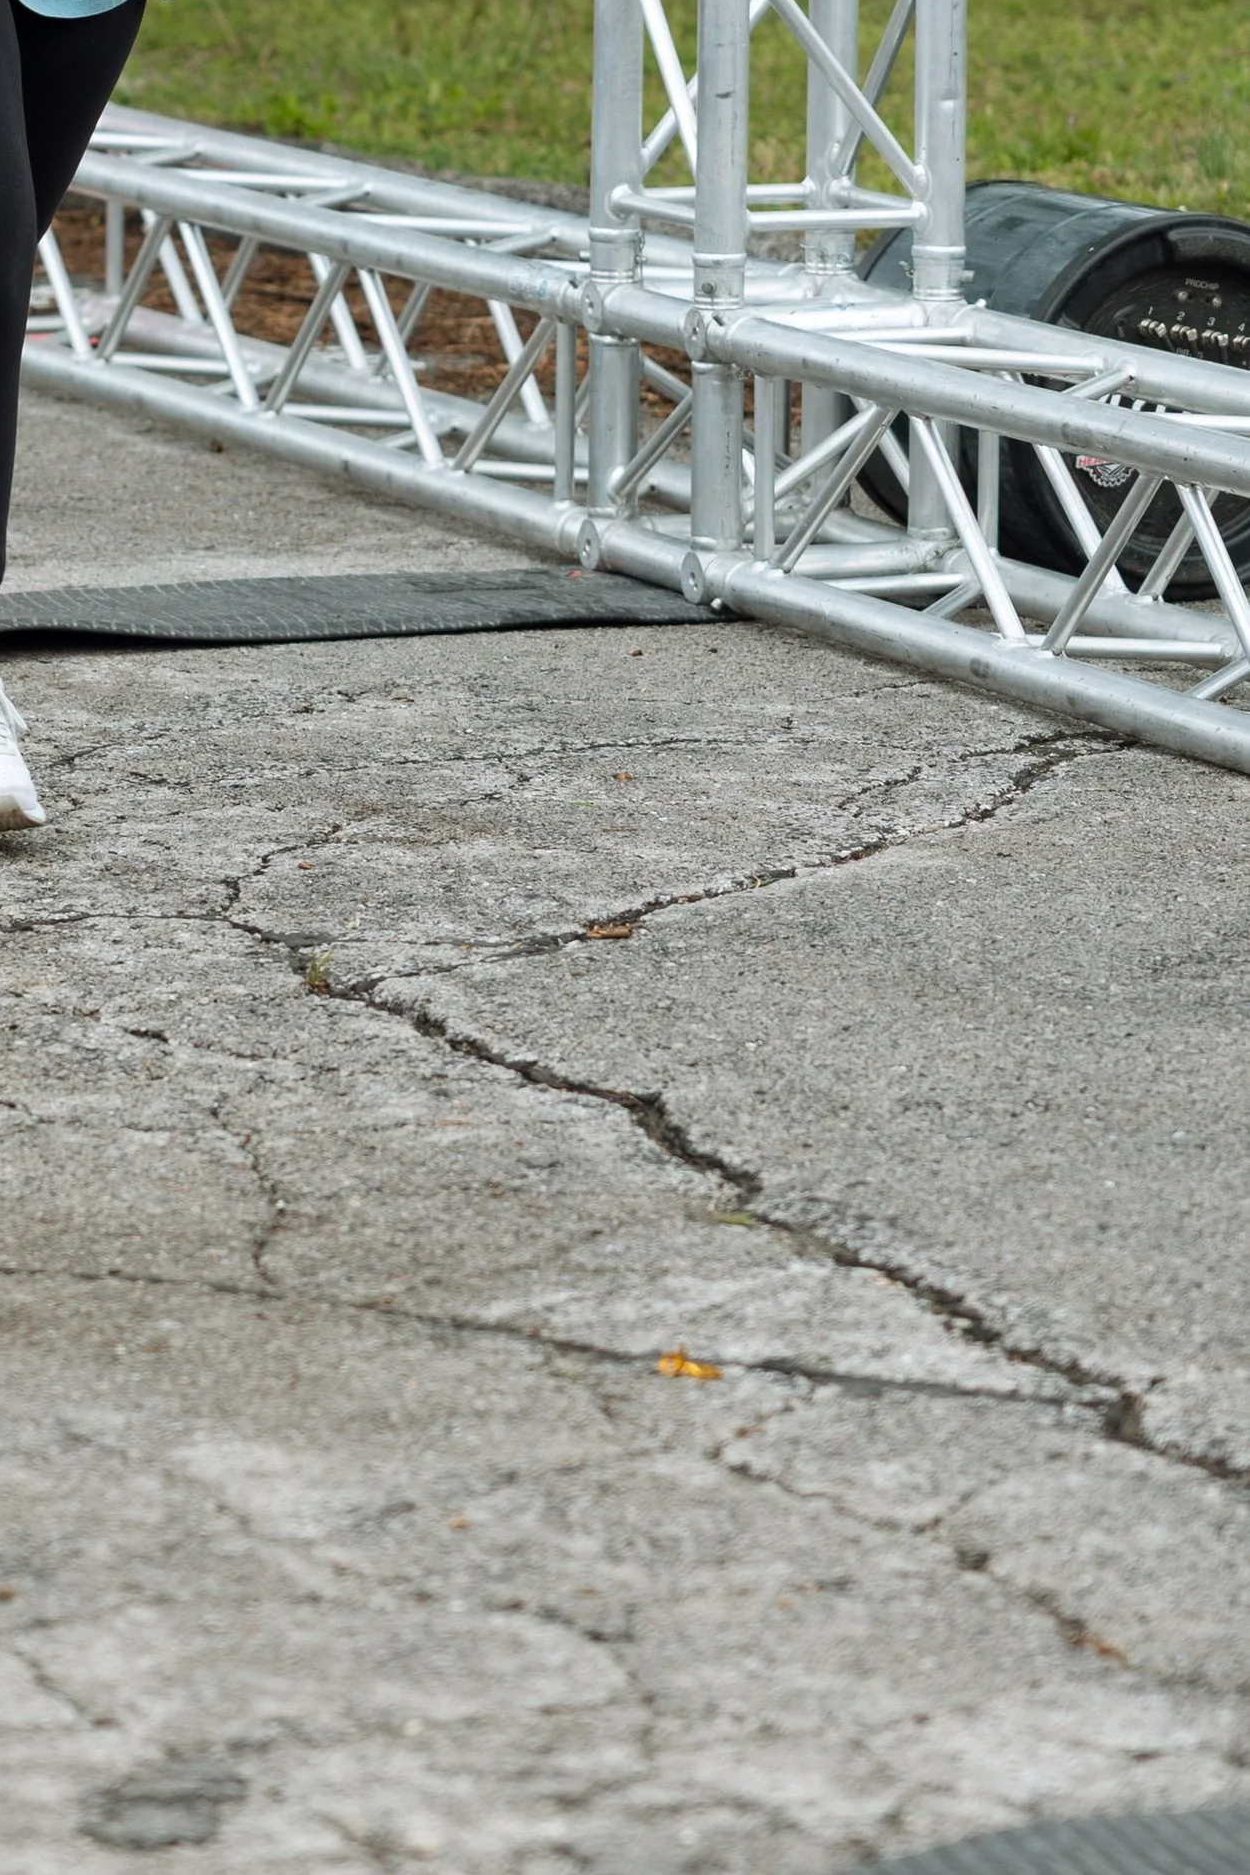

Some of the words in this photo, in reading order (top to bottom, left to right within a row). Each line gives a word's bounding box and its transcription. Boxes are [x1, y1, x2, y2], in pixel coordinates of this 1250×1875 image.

[1185, 278, 1219, 290] PROCHIP
[1148, 306, 1153, 315] 1
[1177, 311, 1185, 321] 2
[1207, 317, 1215, 326] 3
[1238, 323, 1245, 331] 4
